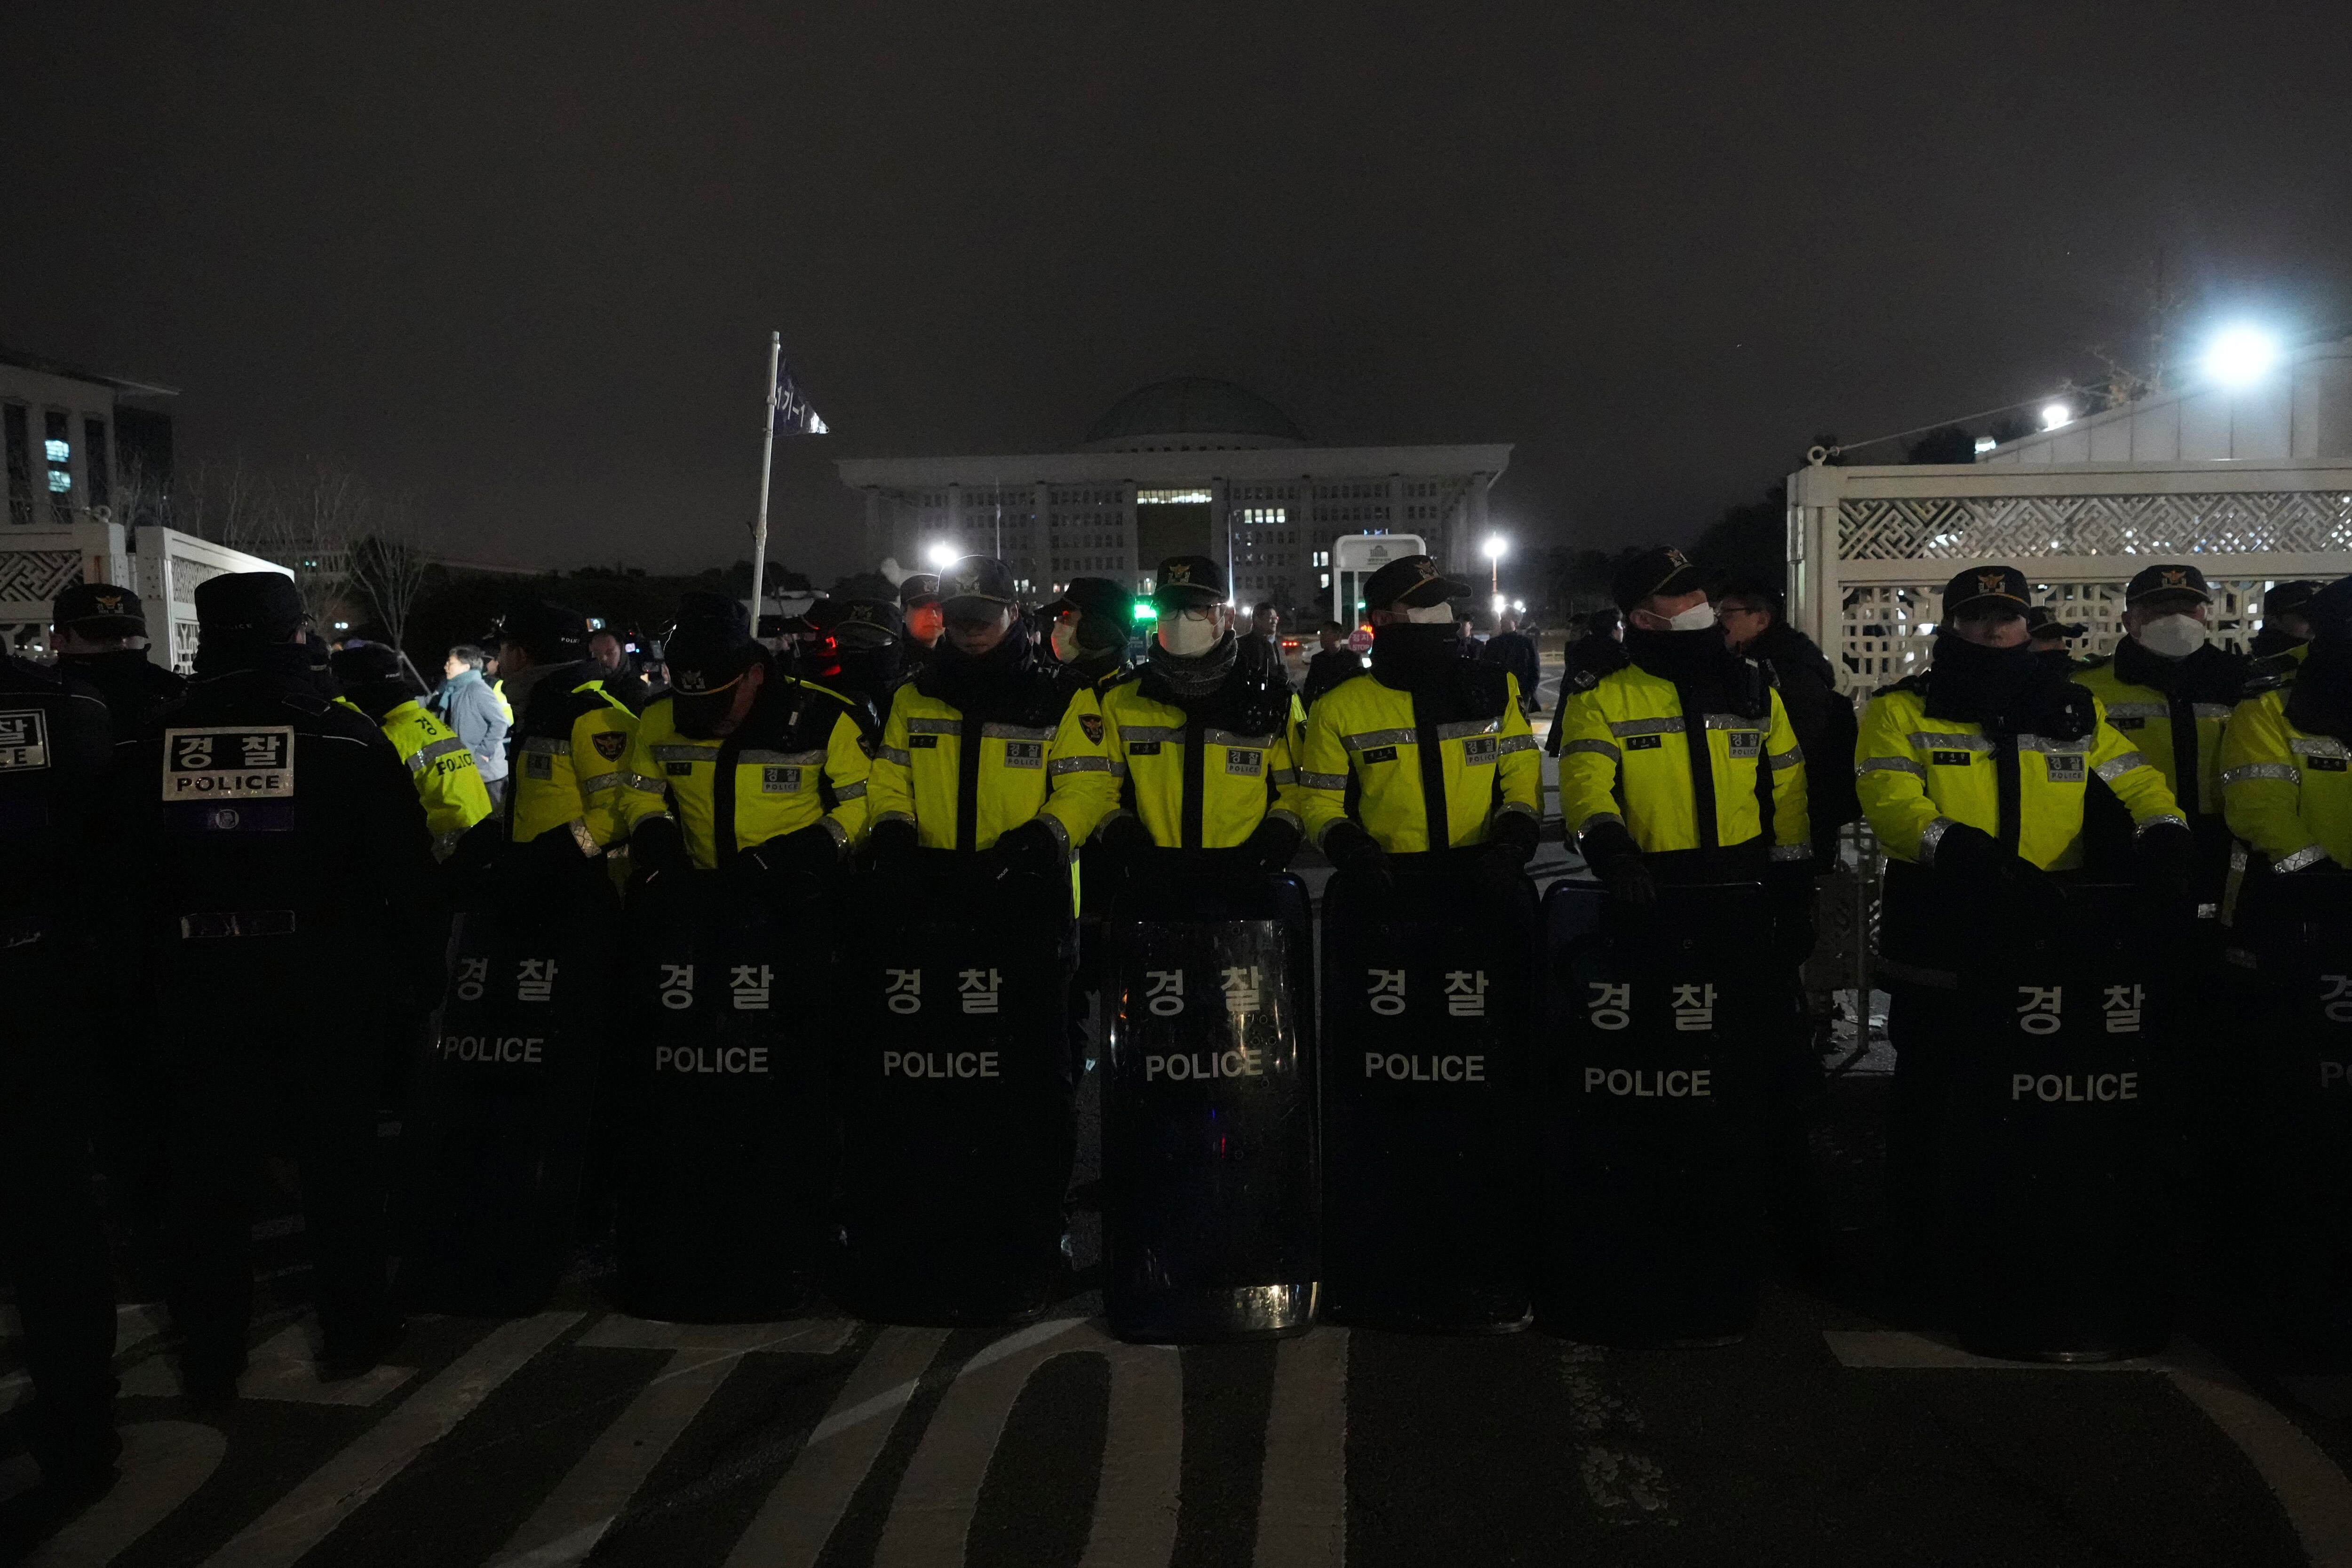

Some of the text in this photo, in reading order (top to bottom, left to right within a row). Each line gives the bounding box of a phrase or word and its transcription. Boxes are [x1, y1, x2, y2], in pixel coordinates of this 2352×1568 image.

[1469, 754, 1495, 763] POLICE
[177, 776, 279, 791] POLICE
[444, 1036, 544, 1063] POLICE
[656, 1045, 768, 1073] POLICE
[884, 1051, 999, 1078] POLICE
[1146, 1050, 1263, 1082] POLICE
[1366, 1052, 1485, 1082] POLICE
[1585, 1067, 1711, 1097] POLICE
[2012, 1072, 2138, 1102] POLICE
